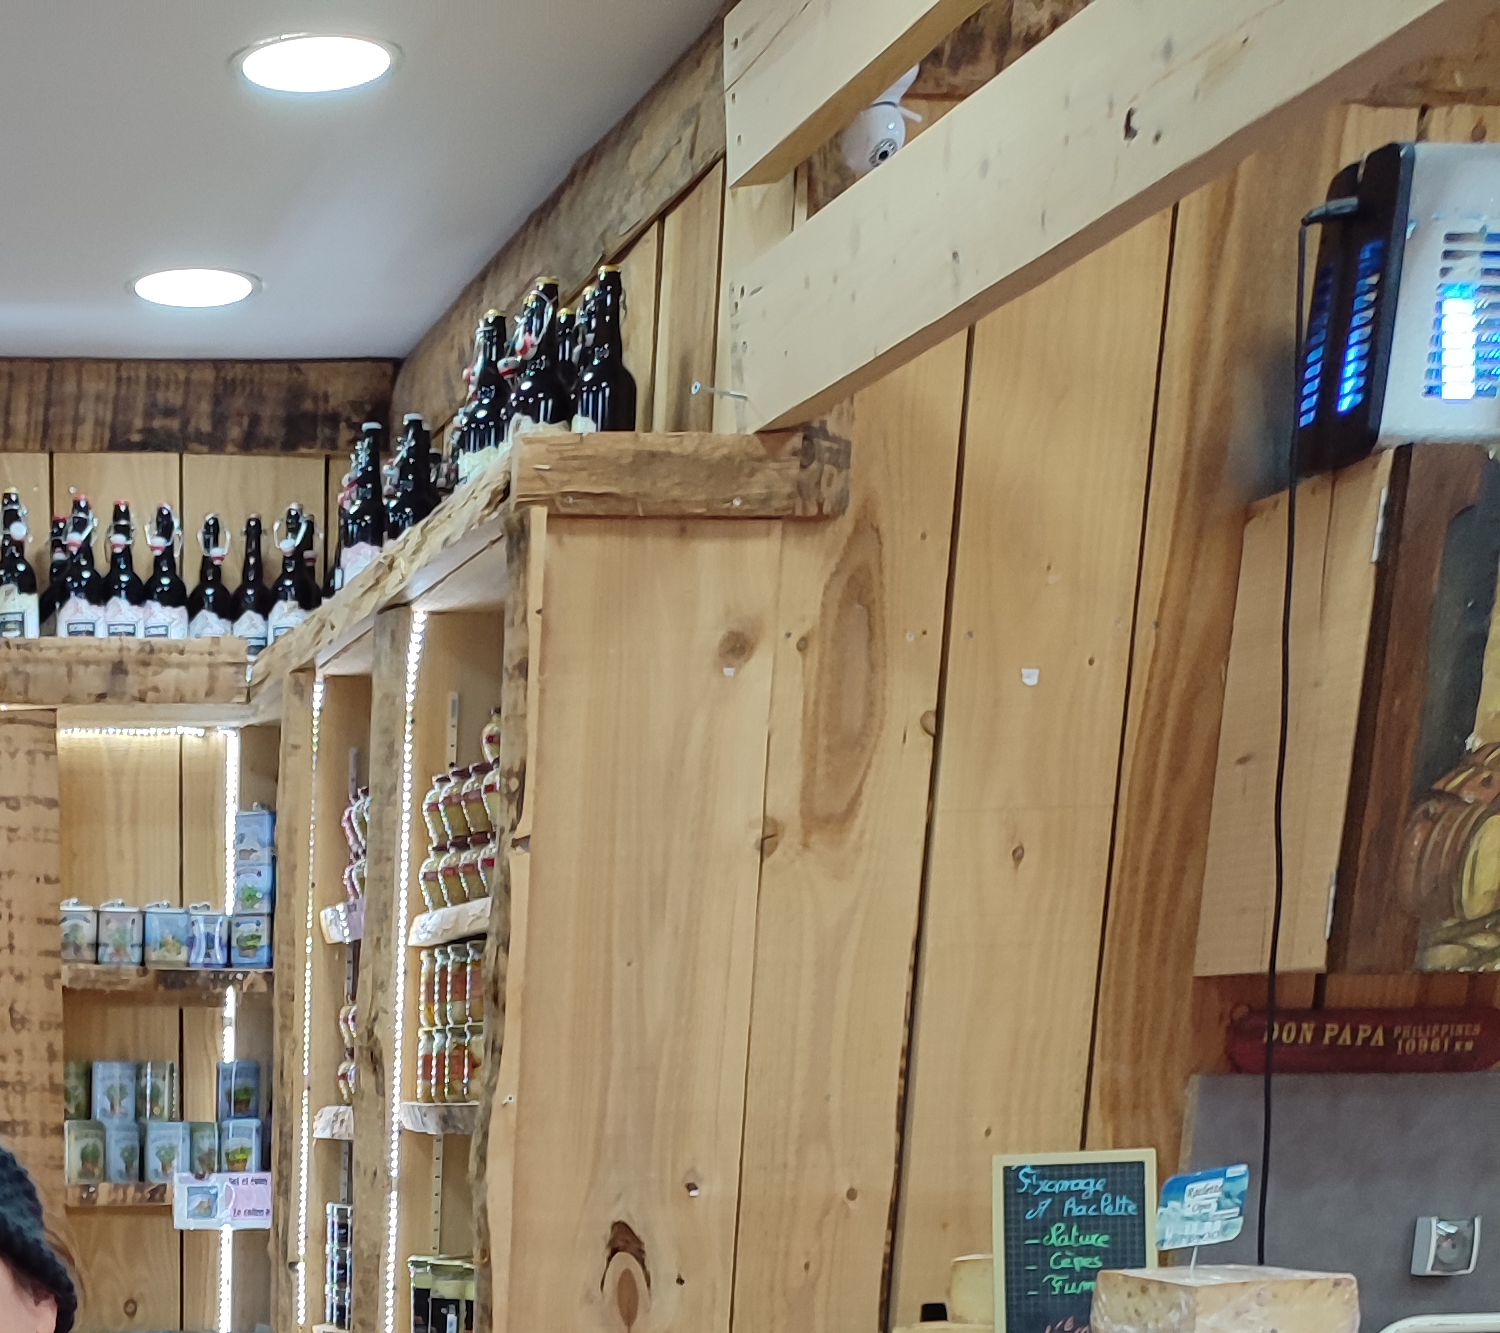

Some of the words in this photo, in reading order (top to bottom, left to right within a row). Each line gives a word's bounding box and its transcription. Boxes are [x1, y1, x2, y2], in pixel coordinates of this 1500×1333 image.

[1264, 1021, 1316, 1045] DON
[1323, 1023, 1385, 1047] PAPA
[1042, 1273, 1097, 1296] Fum
